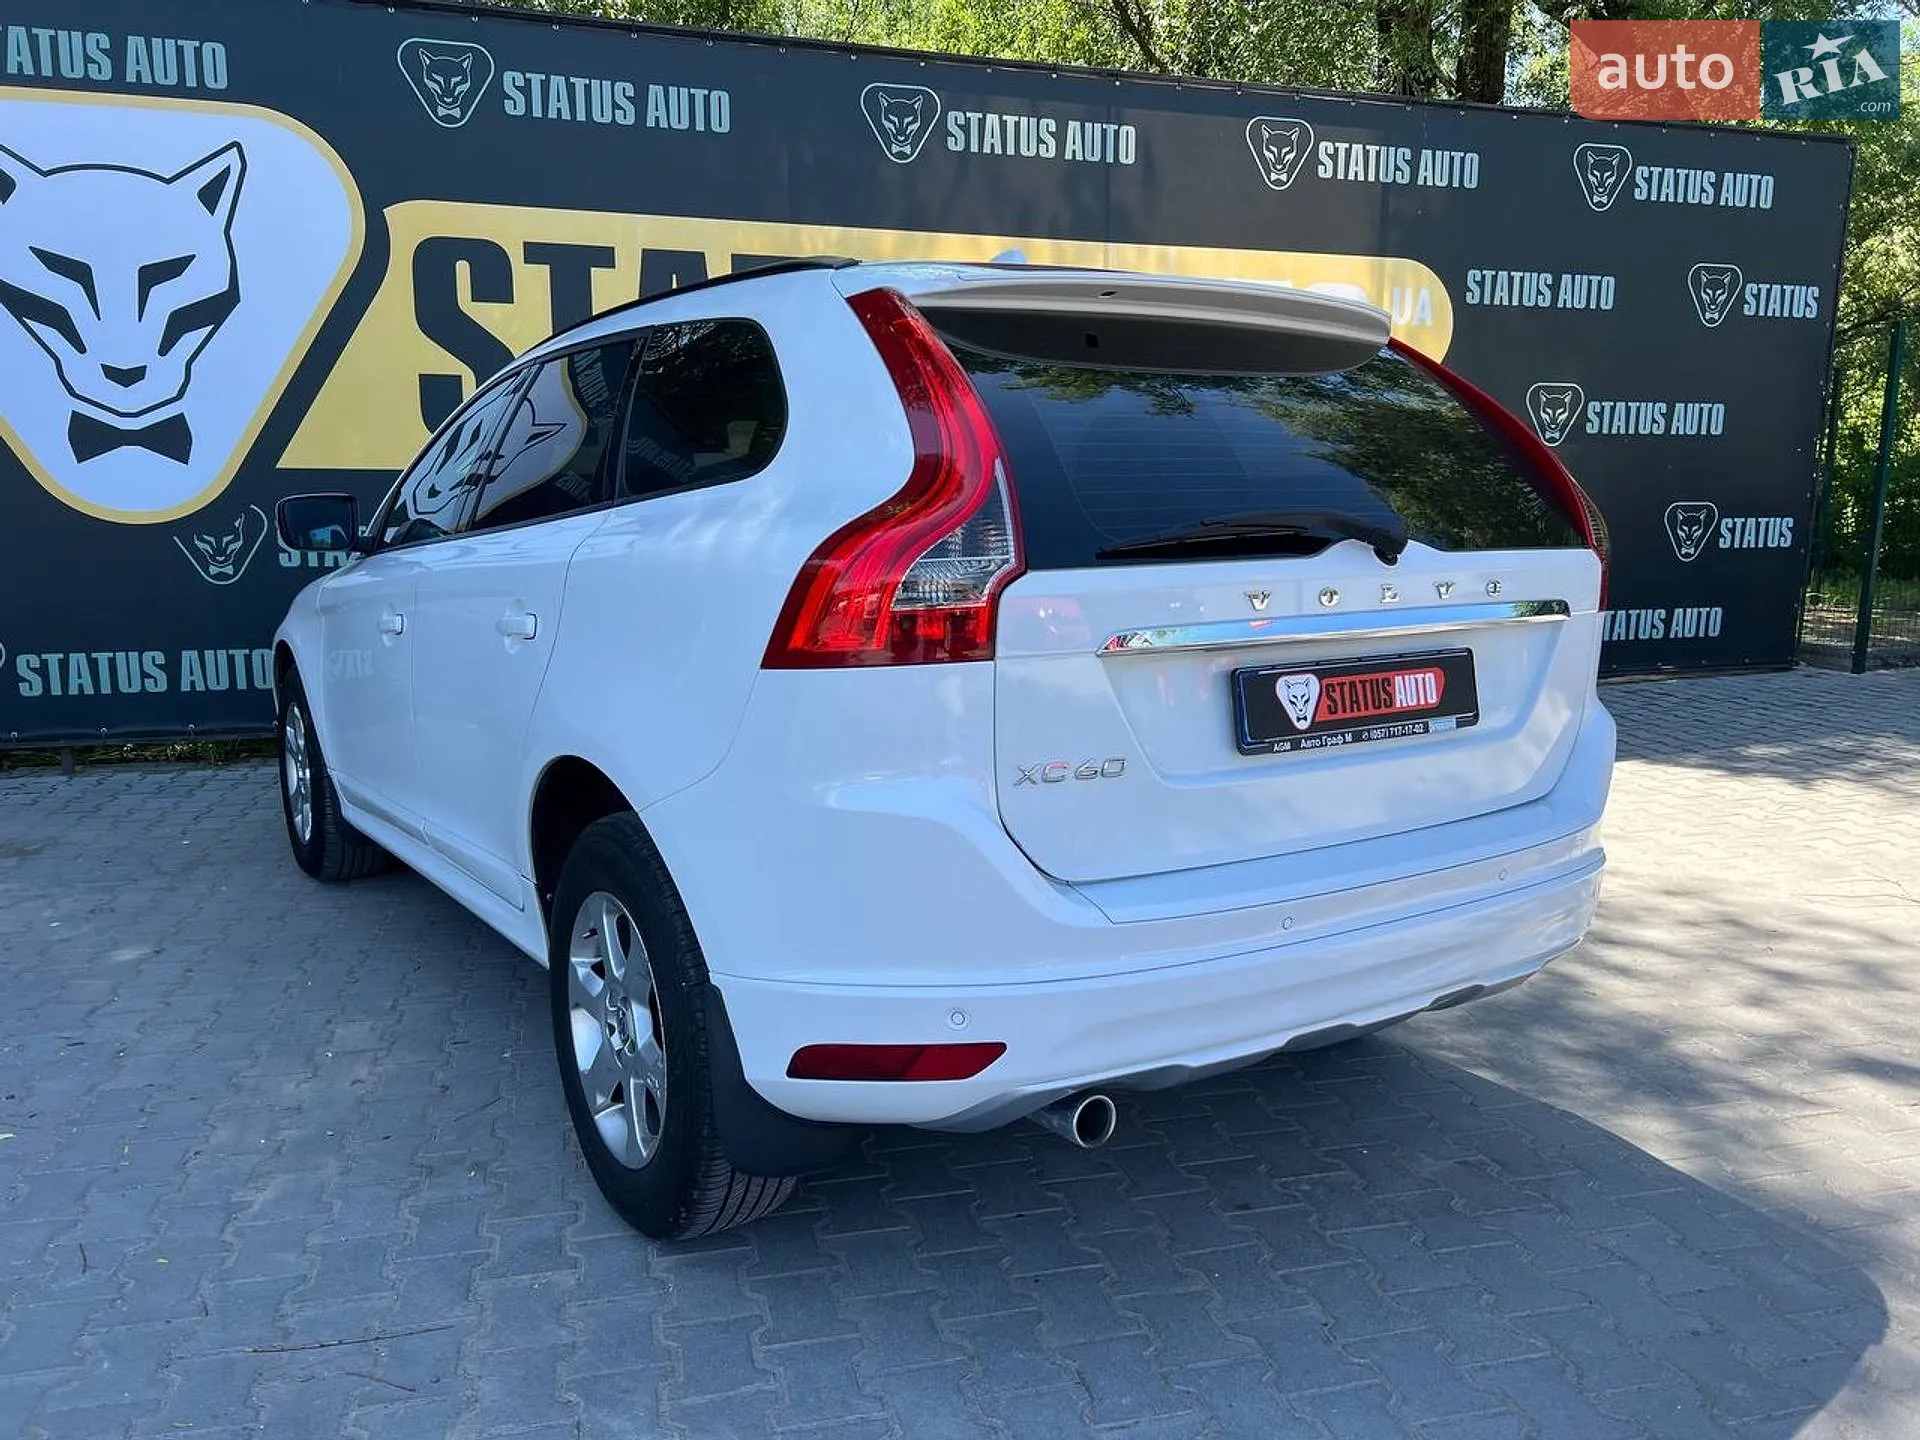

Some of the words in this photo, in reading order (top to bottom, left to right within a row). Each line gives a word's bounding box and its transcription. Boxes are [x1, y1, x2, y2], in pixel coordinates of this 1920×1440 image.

[0, 25, 113, 81] ATUS
[125, 35, 228, 90] AUTO
[503, 70, 637, 126] STATUS
[646, 84, 731, 134] AUTO
[946, 110, 1057, 160] STATUS
[1065, 121, 1137, 165] AUTO
[1317, 141, 1412, 185] STATUS
[1417, 150, 1480, 189] AUTO
[1633, 166, 1716, 206] STATUS
[1719, 173, 1775, 210] AUTO
[1465, 270, 1553, 308] STATUS
[1558, 274, 1616, 311] AUTO
[1743, 284, 1820, 319] STATUS
[1585, 400, 1667, 436] STATUS
[1670, 403, 1726, 436] AUTO
[1718, 517, 1795, 549] STATUS
[1245, 578, 1503, 612] VOLVO
[1603, 609, 1667, 641] TATUS
[1669, 607, 1723, 639] AUTO
[16, 651, 168, 697] STATUS
[180, 648, 274, 692] AUTO
[1012, 757, 1128, 788] XC60
